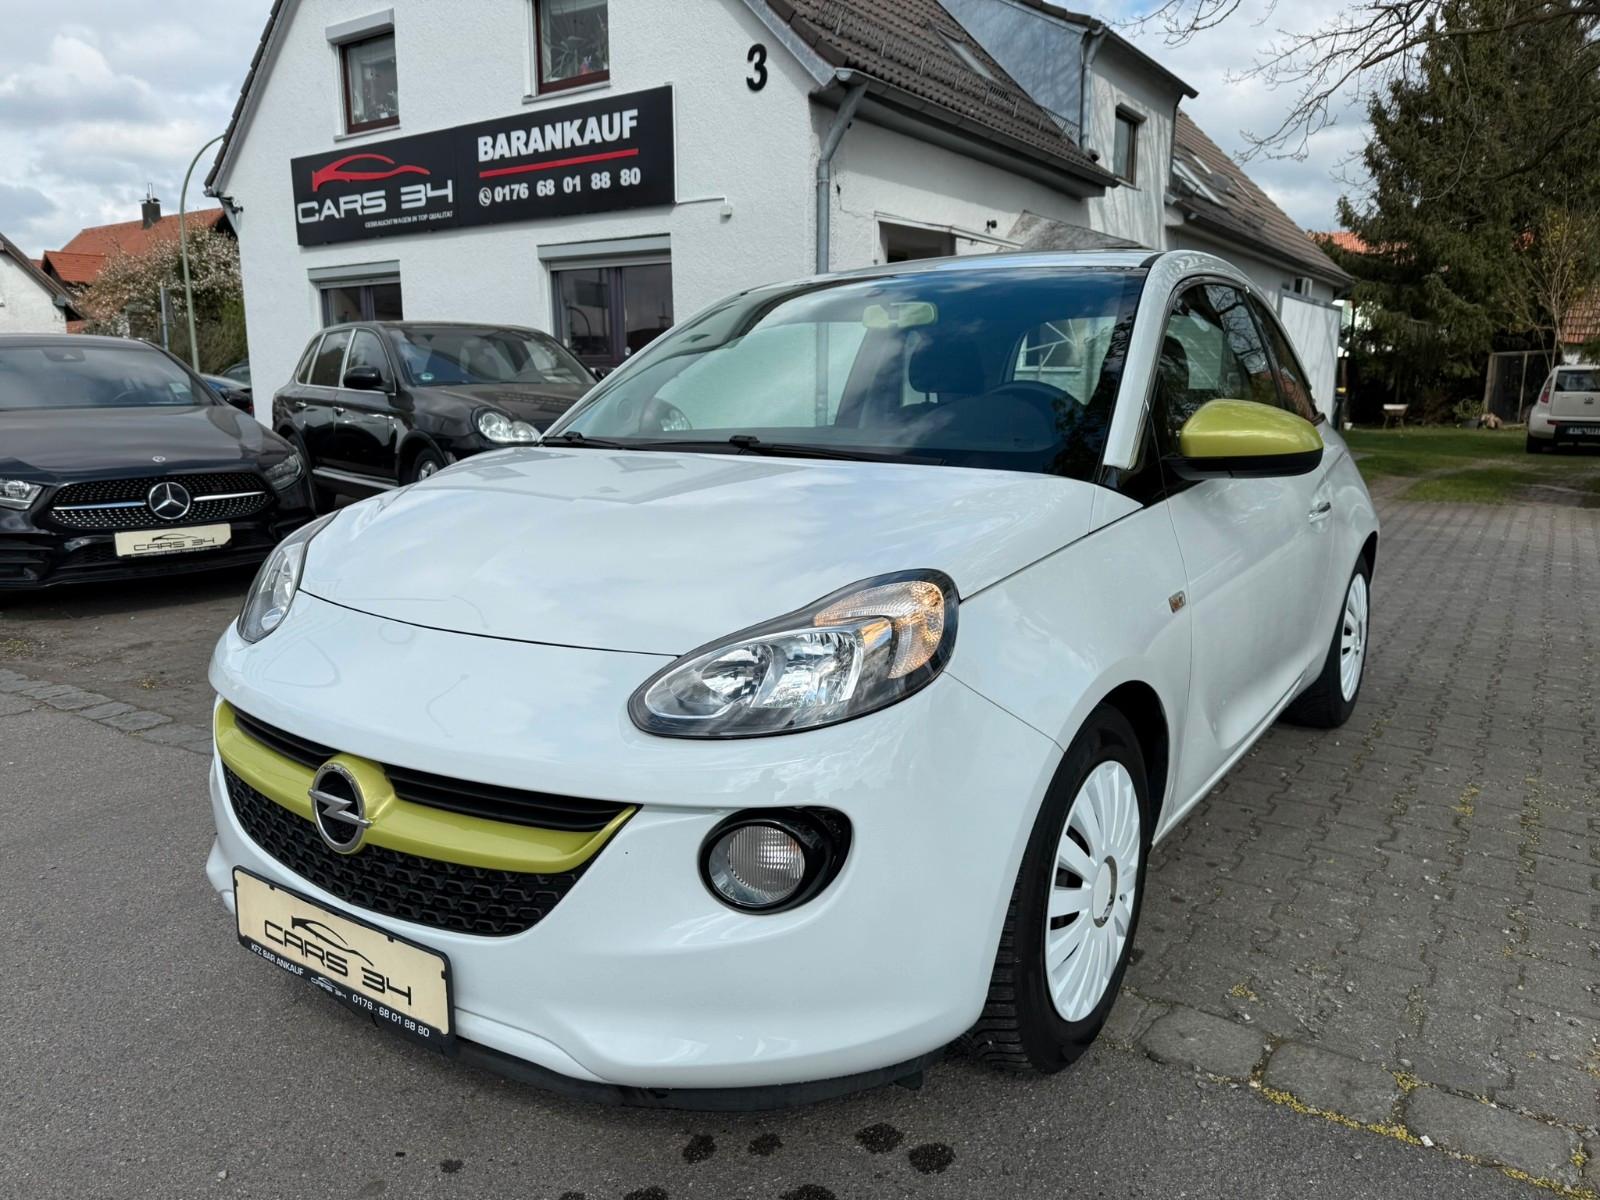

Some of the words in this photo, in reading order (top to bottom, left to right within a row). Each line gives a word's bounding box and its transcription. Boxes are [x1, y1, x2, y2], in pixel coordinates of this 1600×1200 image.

[746, 43, 768, 92] 3
[477, 109, 638, 162] BARANKAUF
[297, 190, 386, 224] CARS
[400, 179, 454, 210] 34
[494, 181, 529, 203] 0176
[536, 178, 555, 197] 68
[563, 175, 581, 193] 01
[591, 171, 611, 190] 88
[620, 167, 641, 187] 80
[133, 540, 185, 551] CARS
[191, 537, 215, 547] 34
[250, 942, 263, 956] KFZ
[262, 949, 276, 963] BAR
[276, 957, 304, 976] ANKAUF
[264, 920, 348, 977] CARS
[361, 966, 412, 1006] 34
[352, 994, 373, 1010] 0176
[379, 1006, 390, 1019] 68
[391, 1012, 402, 1024] 01
[404, 1019, 416, 1031] 88
[417, 1025, 430, 1037] 80
